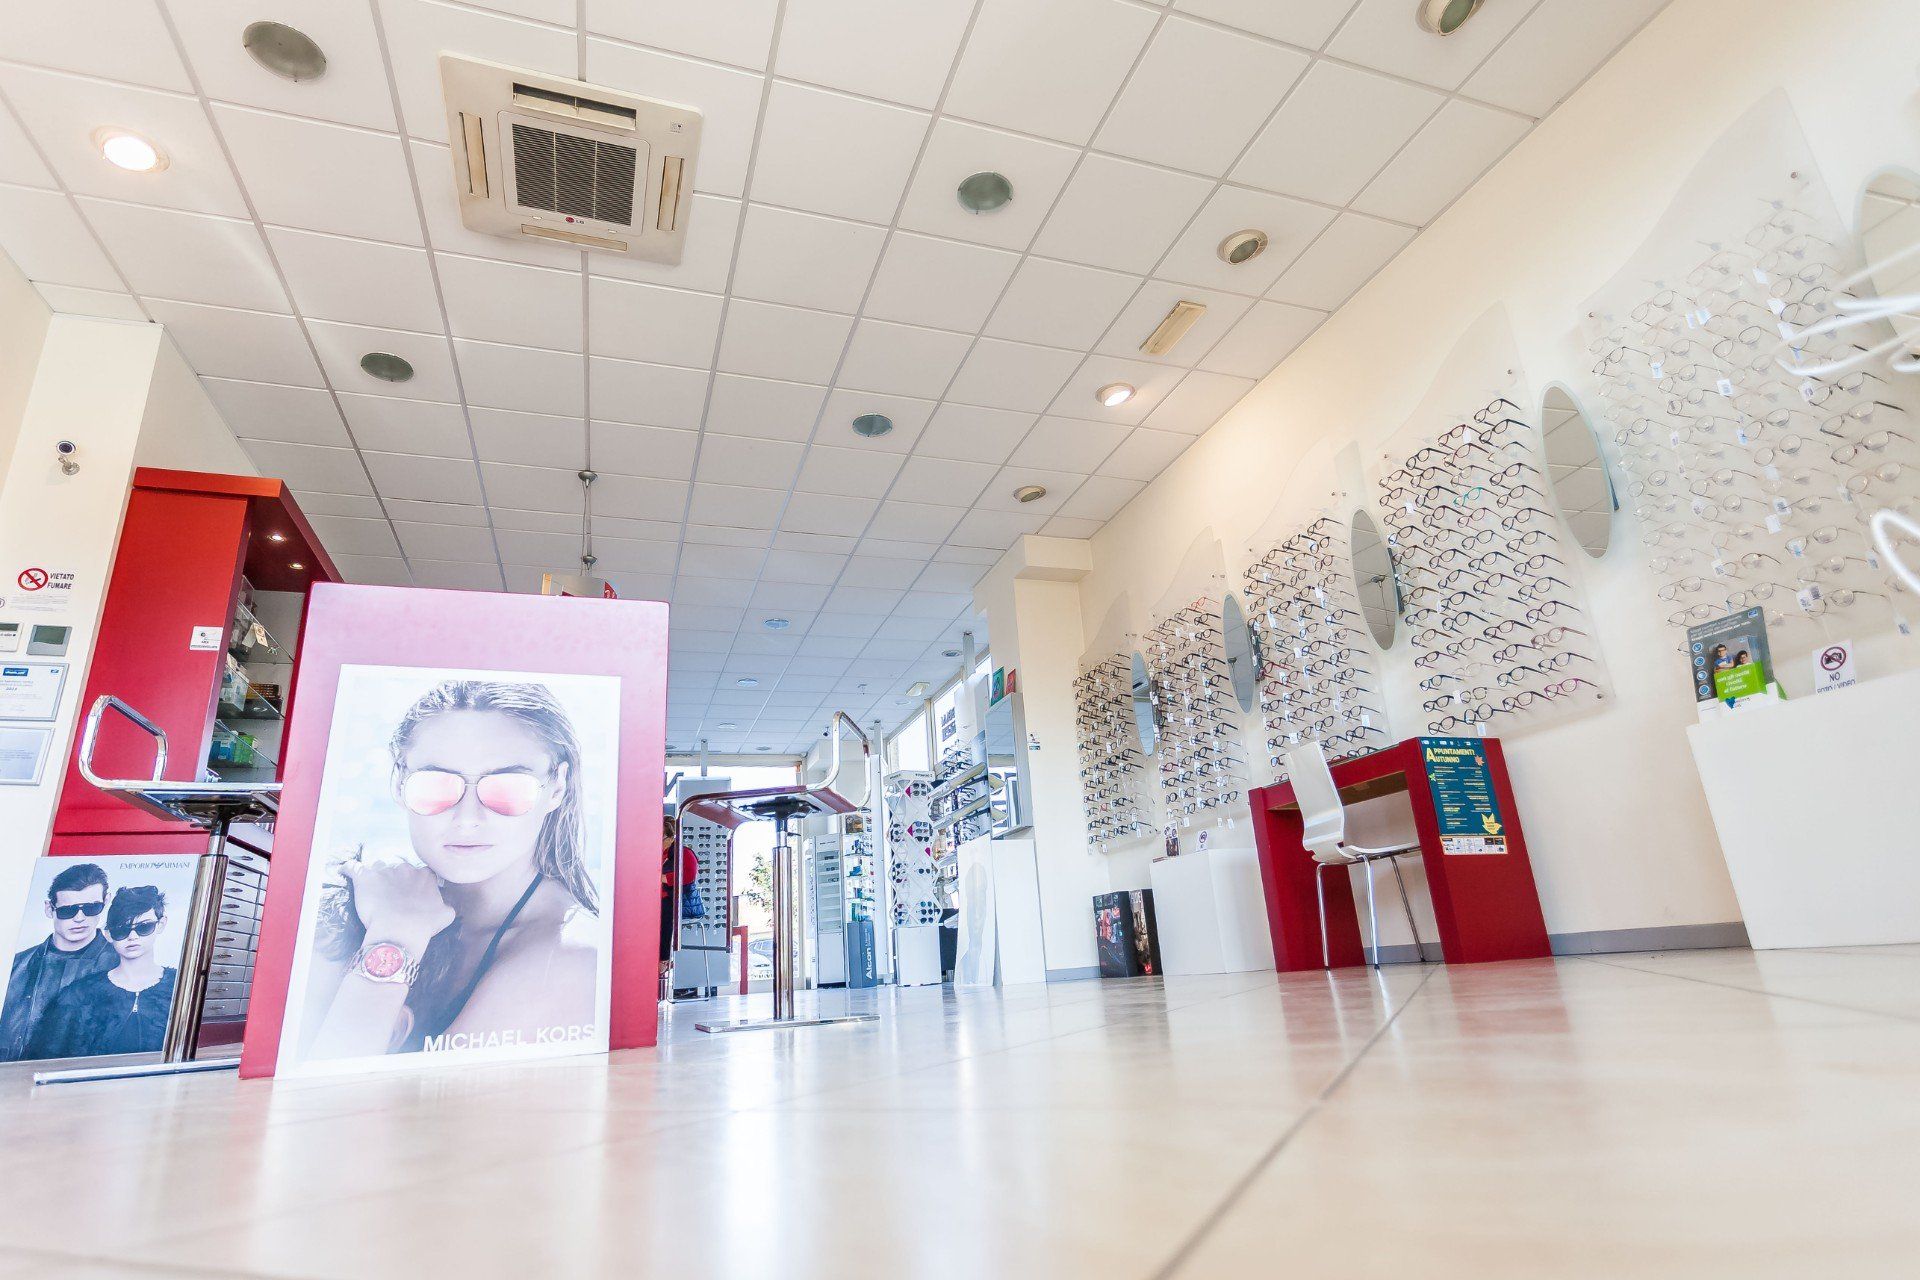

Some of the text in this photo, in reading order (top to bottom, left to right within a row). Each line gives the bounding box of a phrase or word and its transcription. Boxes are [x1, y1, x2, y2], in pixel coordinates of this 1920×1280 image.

[1829, 671, 1841, 682] NO
[119, 862, 154, 870] EMPORIO
[865, 947, 873, 980] Alcon
[423, 1024, 595, 1052] MICHAEL KORS
